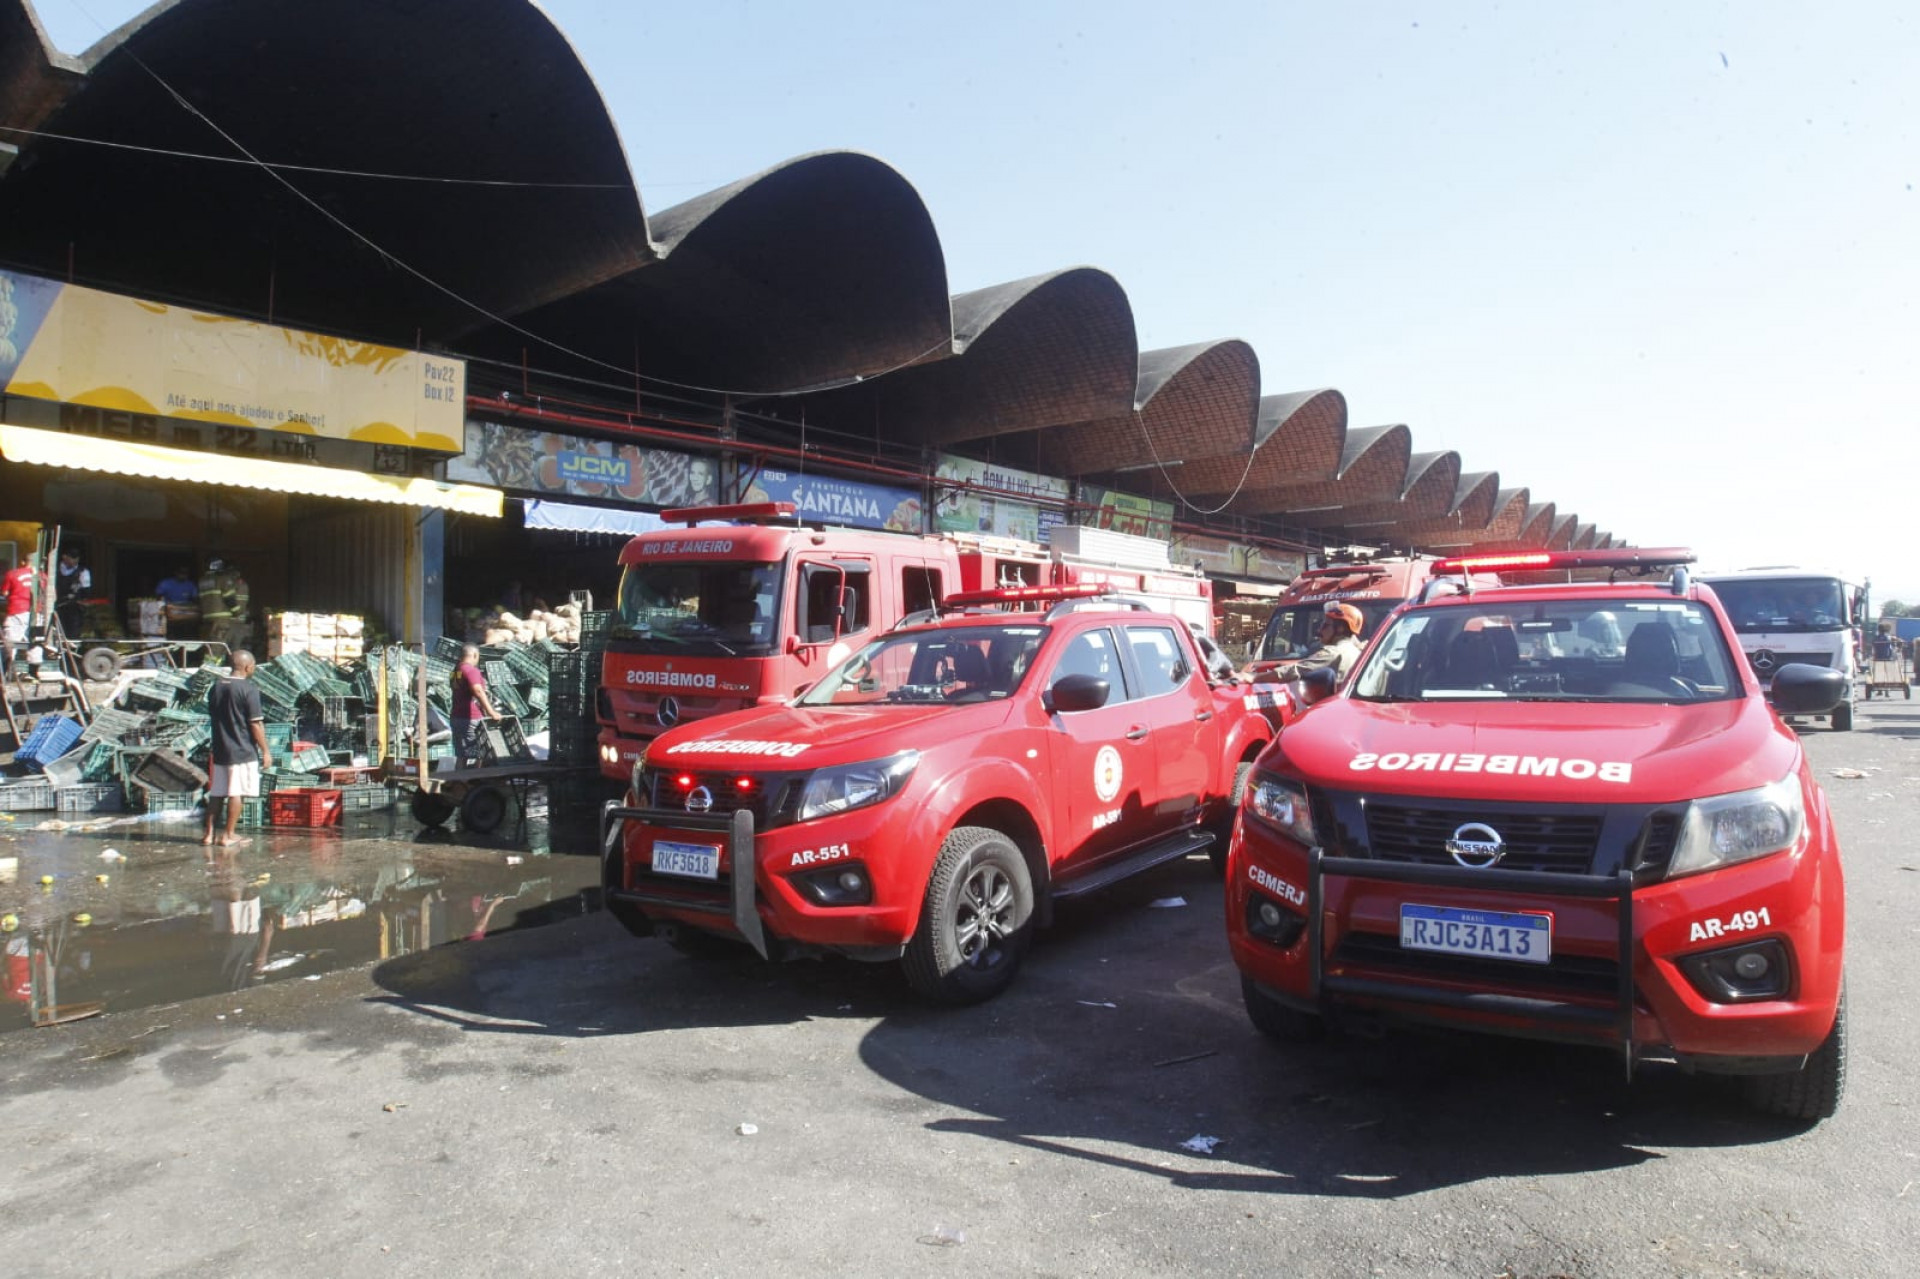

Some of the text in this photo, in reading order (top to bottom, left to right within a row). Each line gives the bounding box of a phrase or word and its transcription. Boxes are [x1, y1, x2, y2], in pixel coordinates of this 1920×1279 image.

[424, 361, 455, 384] Pav22
[424, 382, 455, 403] Box 12
[240, 404, 274, 420] ajudou
[563, 456, 626, 477] JCM
[792, 487, 880, 519] SANTANA
[643, 540, 733, 555] RIO DE JANEIRO
[791, 843, 849, 866] AR-551
[1451, 842, 1500, 853] NISSAN
[1248, 864, 1305, 906] CBMERJ
[1689, 906, 1771, 942] AR-491
[1413, 919, 1531, 956] RJC3A13
